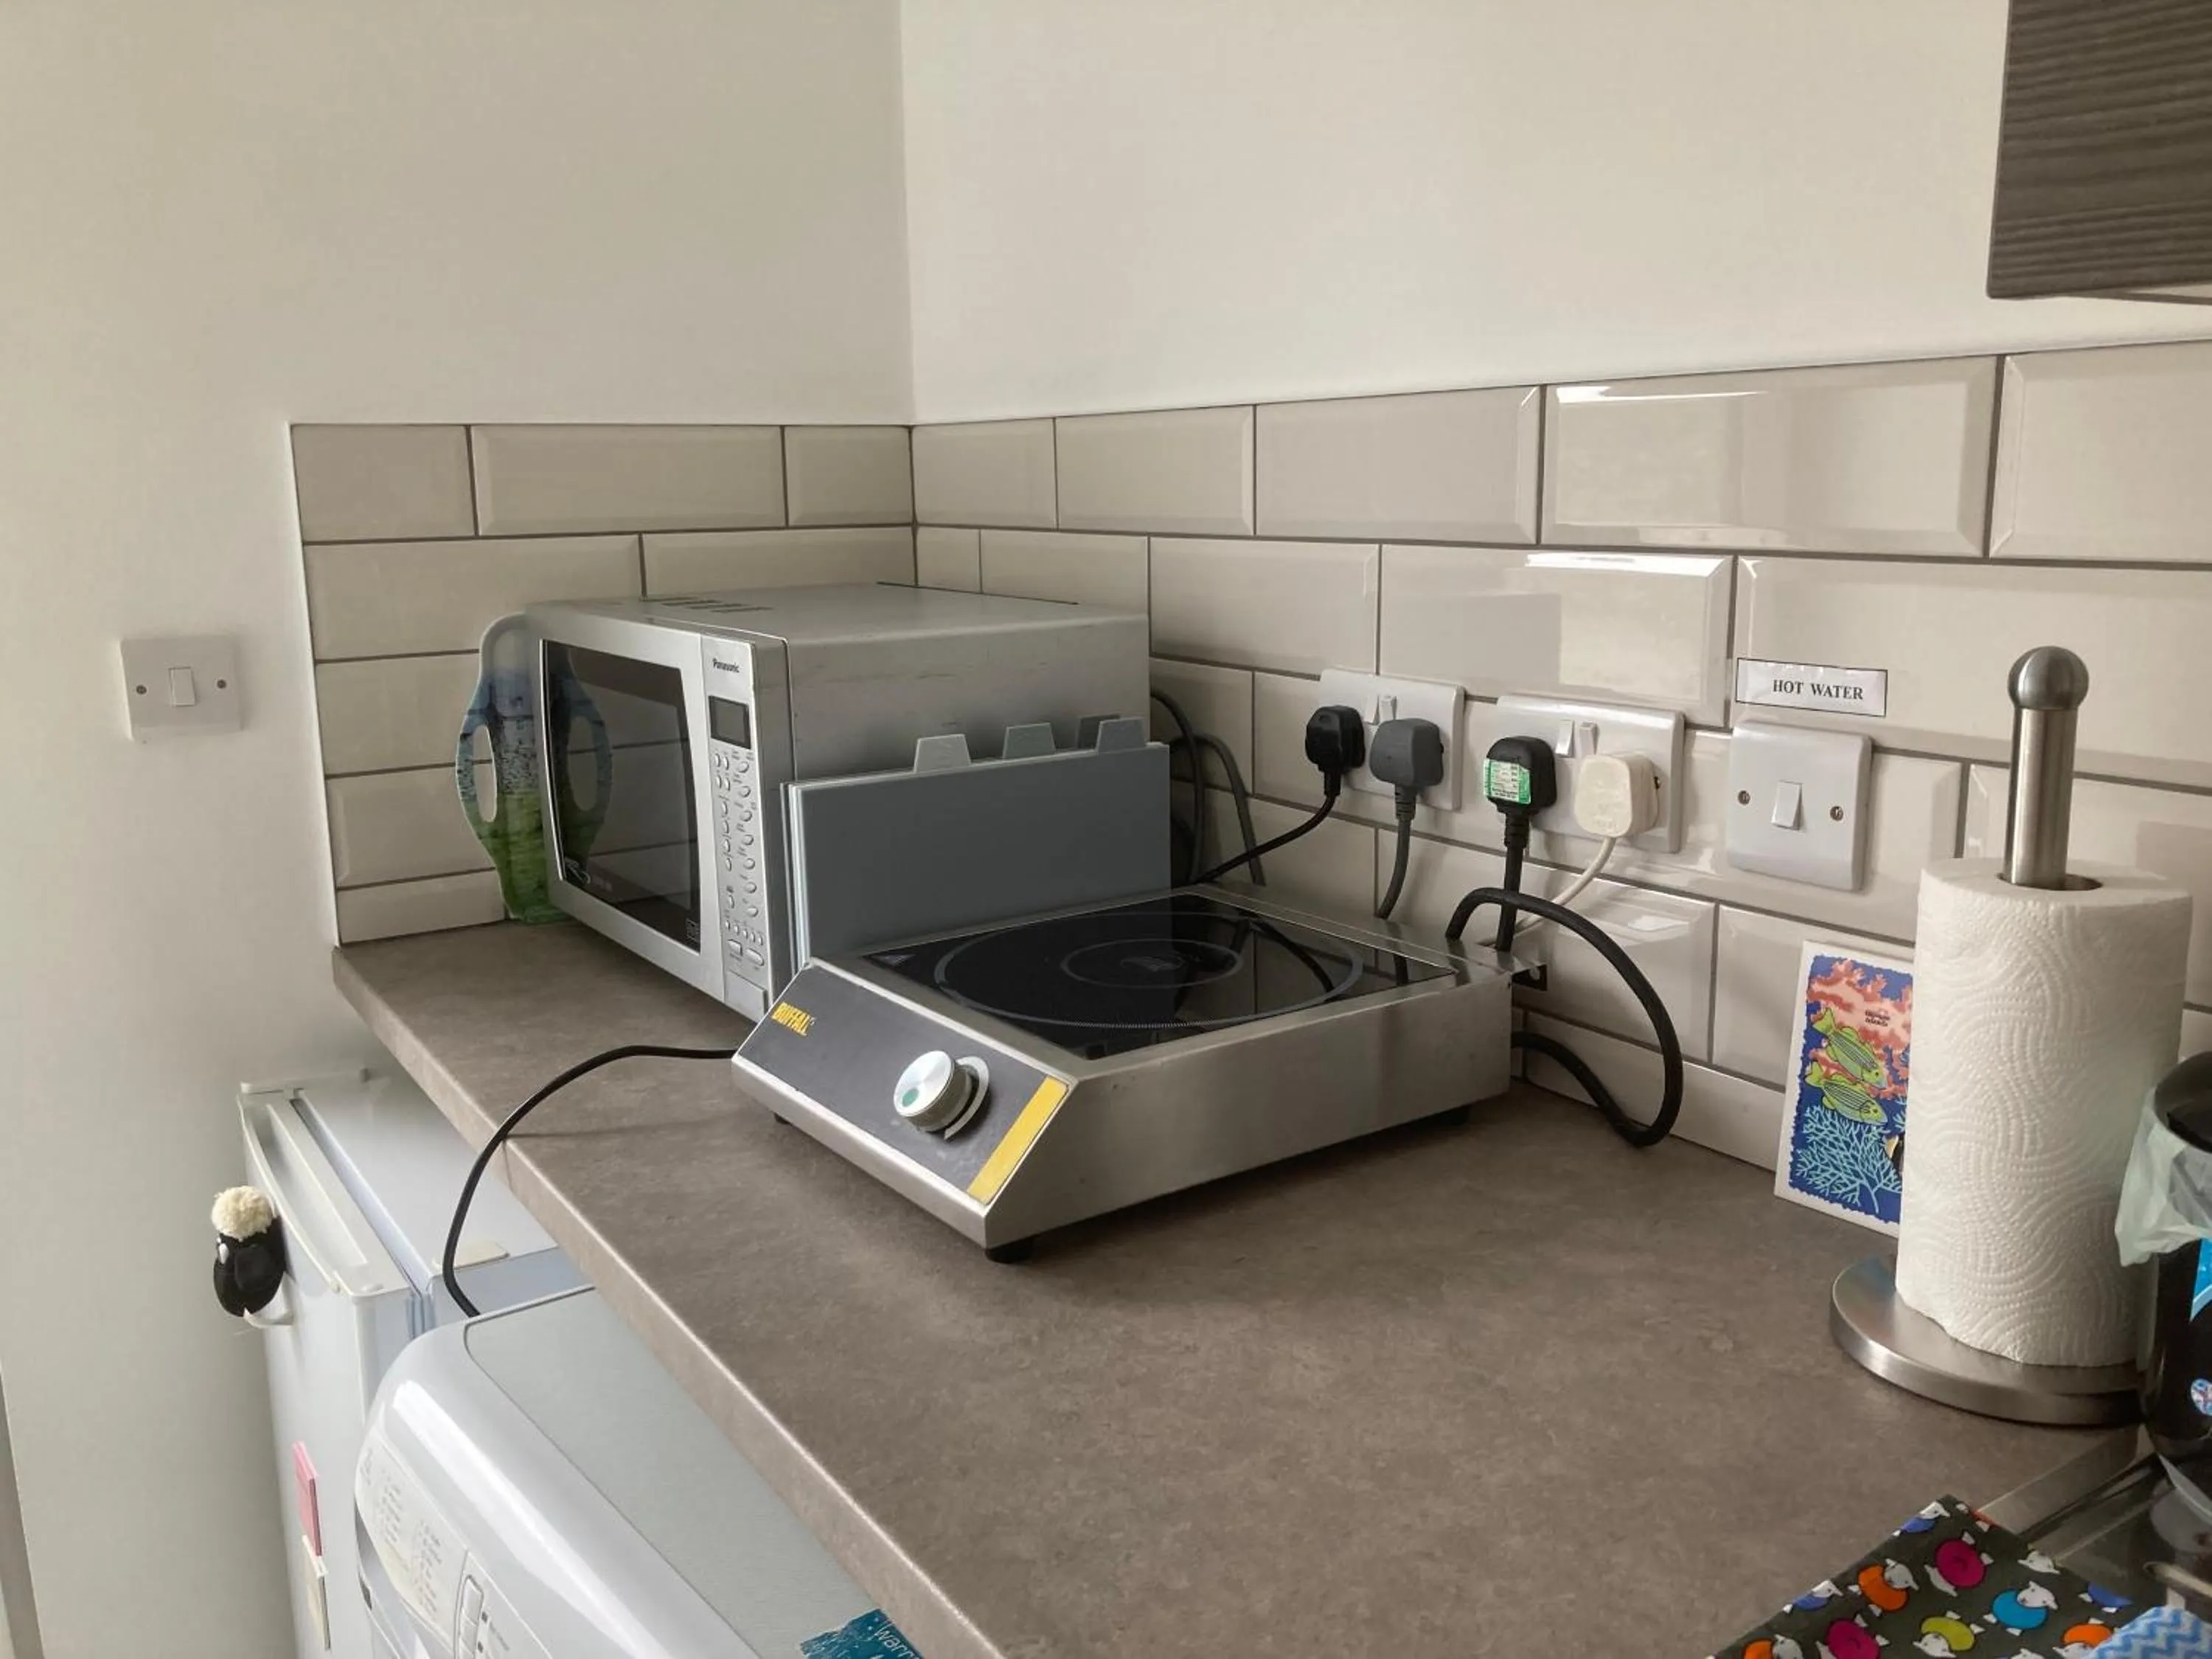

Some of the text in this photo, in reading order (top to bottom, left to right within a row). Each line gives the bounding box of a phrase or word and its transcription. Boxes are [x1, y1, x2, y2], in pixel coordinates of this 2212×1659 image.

[712, 658, 740, 672] Panasonic
[1773, 679, 1863, 700] HOT WATER
